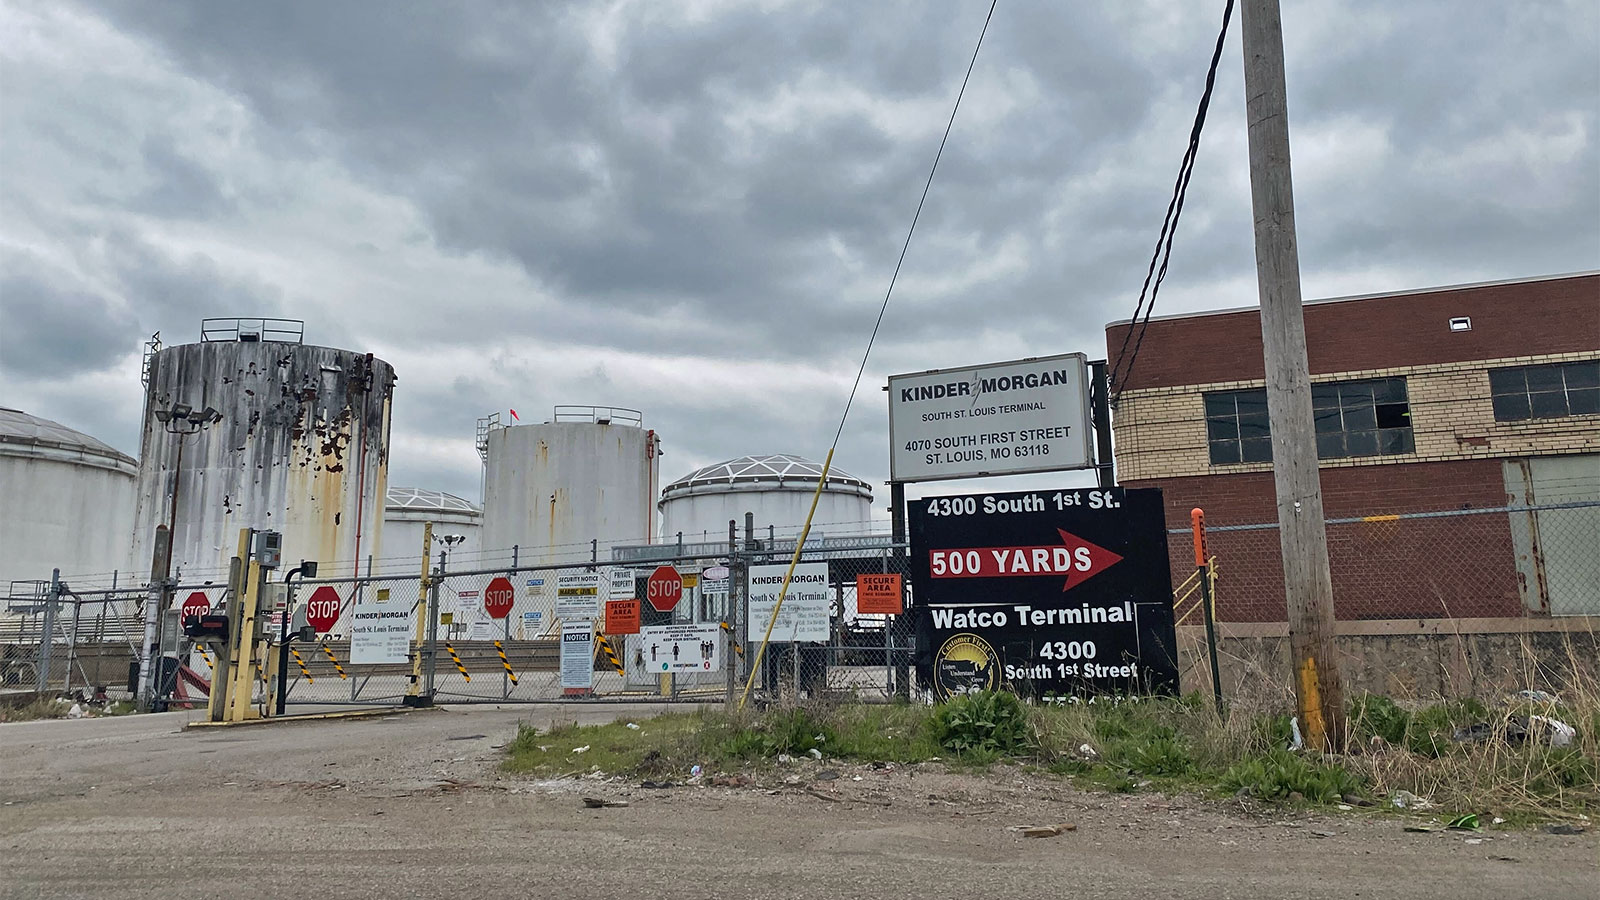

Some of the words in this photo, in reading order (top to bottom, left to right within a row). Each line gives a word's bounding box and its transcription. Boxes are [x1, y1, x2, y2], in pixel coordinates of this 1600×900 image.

[902, 382, 970, 402] KINDER
[982, 370, 1068, 394] MORGAN
[922, 412, 952, 422] SOUTH
[954, 410, 967, 418] ST.
[969, 406, 996, 417] LOUIS
[998, 402, 1046, 414] TERMINAL
[905, 439, 931, 452] 4070
[934, 434, 976, 449] SOUTH
[980, 431, 1016, 445] FIRST
[1020, 426, 1071, 442] STREET
[926, 454, 943, 465] ST.
[946, 450, 987, 463] LOUIS,
[990, 446, 1011, 460] MO
[1014, 444, 1050, 457] 63118
[928, 497, 976, 516] 4300
[982, 494, 1046, 514] South
[1052, 491, 1082, 510] 1st
[1088, 490, 1120, 509] St.
[932, 550, 981, 576] 500
[991, 546, 1092, 573] YARDS
[650, 580, 680, 597] STOP
[752, 576, 782, 584] KINDER
[486, 590, 512, 606] STOP
[750, 593, 768, 602] South
[769, 593, 777, 601] St.
[798, 592, 827, 601] Terminal
[308, 600, 338, 618] STOP
[932, 608, 1008, 629] Watco
[1014, 601, 1133, 626] Terminal
[941, 636, 970, 656] Customer
[1040, 640, 1096, 660] 4300
[1005, 664, 1052, 680] South
[1057, 662, 1078, 678] 1st
[1084, 662, 1138, 678] Street
